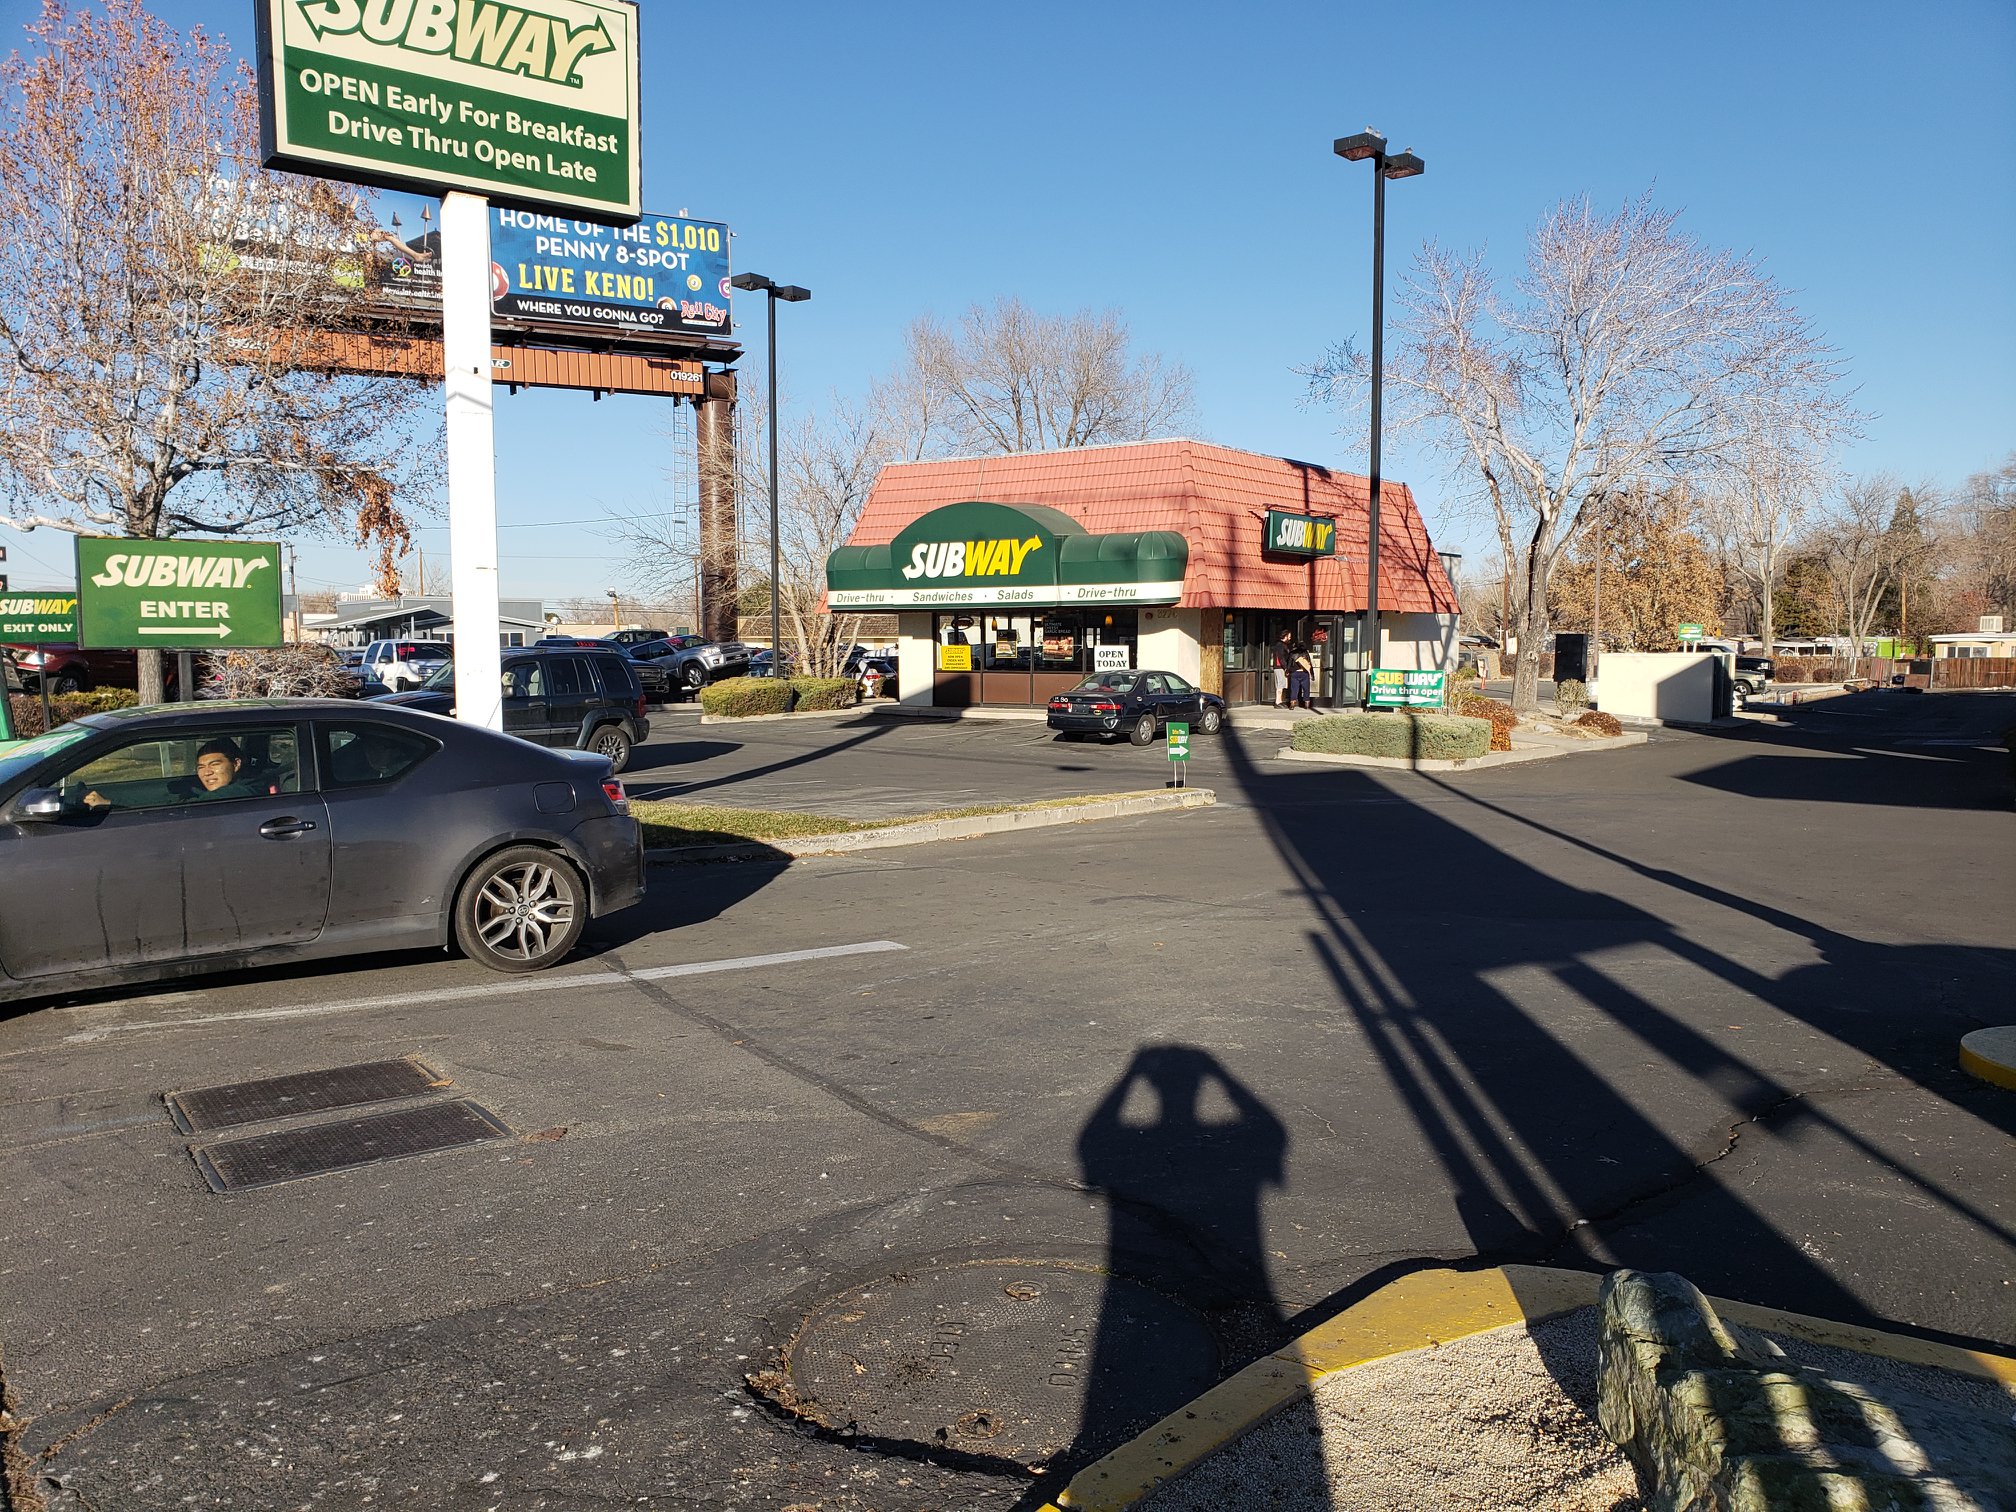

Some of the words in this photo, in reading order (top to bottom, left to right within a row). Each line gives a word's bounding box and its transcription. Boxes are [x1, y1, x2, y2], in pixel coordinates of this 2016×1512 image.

[299, 68, 380, 106] OPEN
[387, 85, 454, 125] Early
[459, 102, 501, 129] For
[505, 111, 619, 155] Breakfast
[328, 110, 403, 146] Drive
[406, 126, 469, 159] Thru
[474, 140, 541, 172] Open
[547, 153, 598, 183] Late
[500, 208, 569, 234] HOME
[655, 220, 720, 252] $1,010
[535, 235, 611, 263] PENNY
[615, 245, 690, 271] 8-SPOT
[518, 263, 575, 293] LIVE
[584, 270, 654, 302] KENO!
[516, 299, 562, 315] WHERE
[564, 304, 592, 318] YOU
[593, 306, 638, 322] GONNA
[640, 311, 665, 325] GO?
[681, 300, 703, 318] Rail
[705, 302, 727, 327] City
[670, 371, 703, 382] 019261
[1276, 518, 1333, 550] SUBWAY
[902, 535, 1043, 581] SUBWAY
[91, 554, 270, 589] SUBWAY
[0, 598, 77, 615] SUBWAY
[836, 592, 885, 604] Drive-thru
[912, 590, 974, 603] Sandwiches
[997, 589, 1034, 601] Salads
[1077, 586, 1137, 599] Drive-thru
[140, 600, 231, 619] ENTER
[3, 623, 35, 633] EXIT
[38, 623, 73, 633] ONLY
[1096, 659, 1128, 668] TODAY
[1098, 650, 1124, 659] OPEN
[1371, 685, 1397, 694] Drive
[1398, 686, 1419, 695] thru
[1373, 671, 1443, 686] SUBWAY
